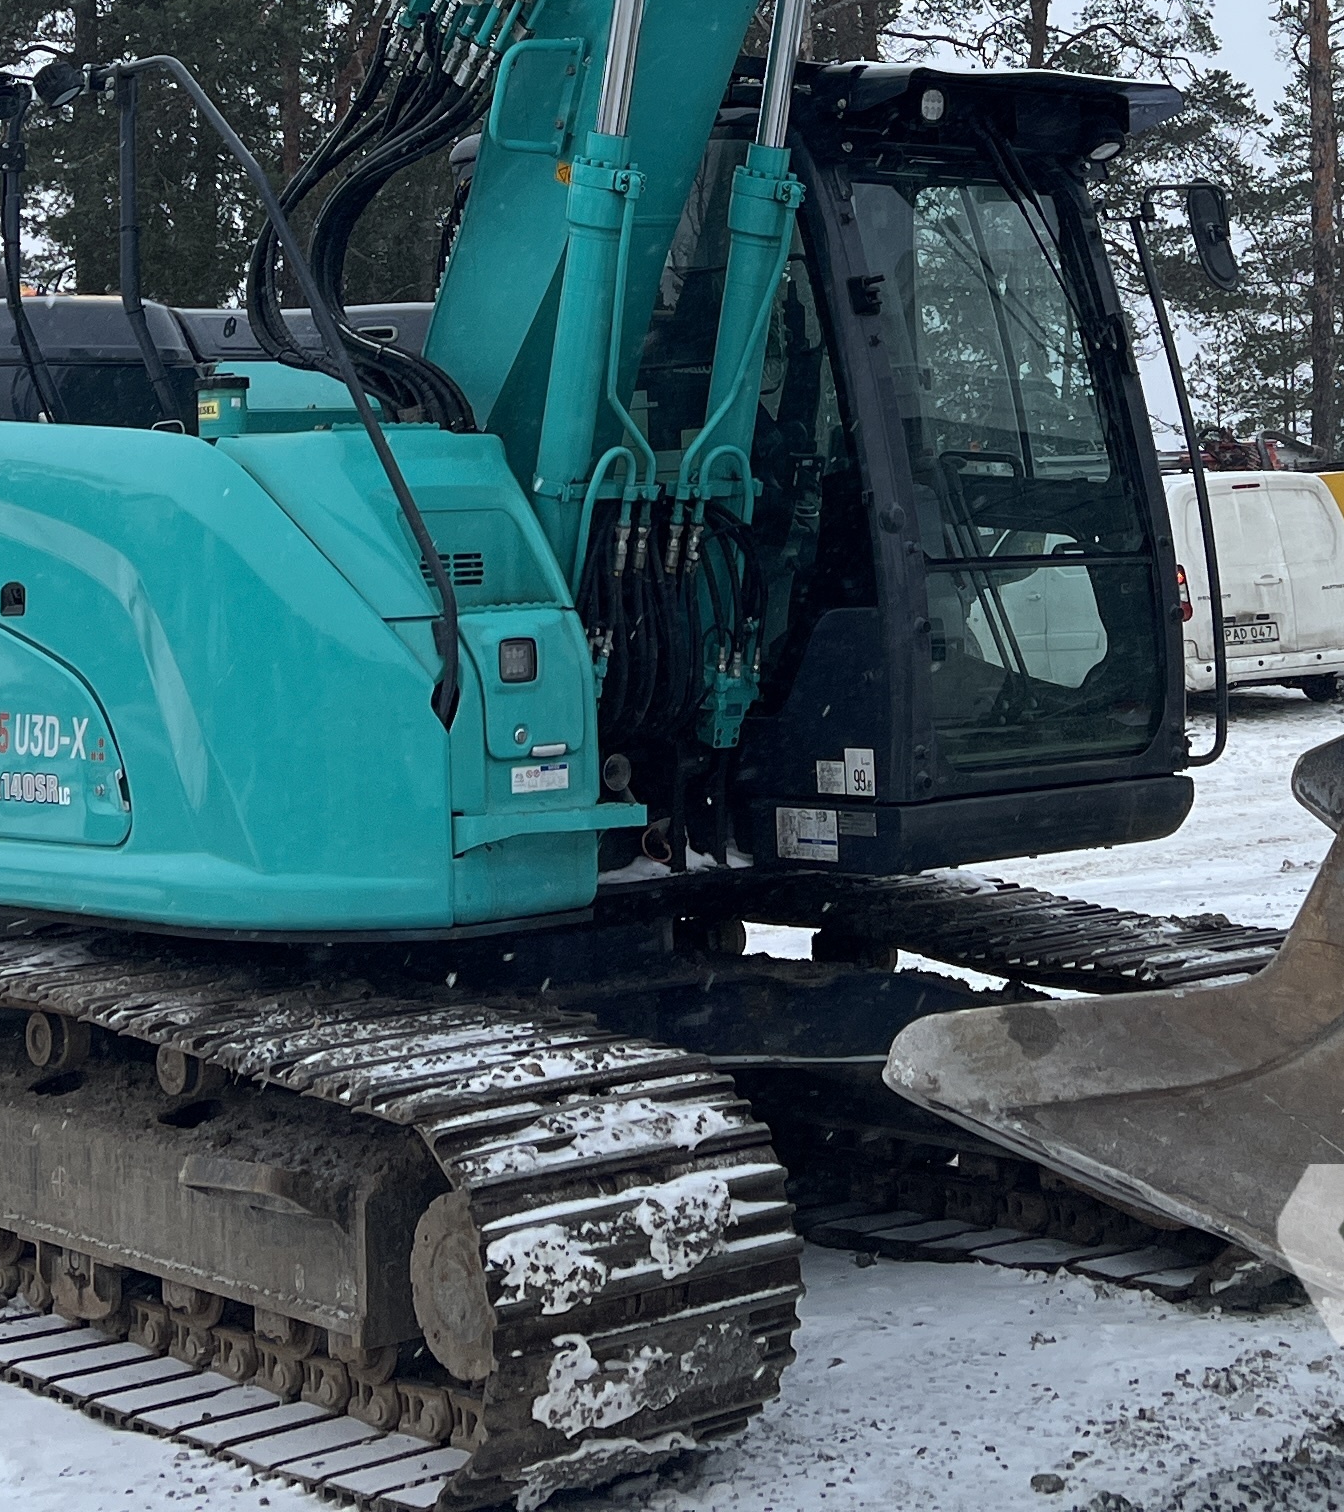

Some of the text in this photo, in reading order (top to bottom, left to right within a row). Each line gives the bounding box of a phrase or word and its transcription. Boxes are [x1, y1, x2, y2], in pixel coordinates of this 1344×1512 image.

[1225, 625, 1273, 641] PAD 047
[853, 768, 866, 792] 99
